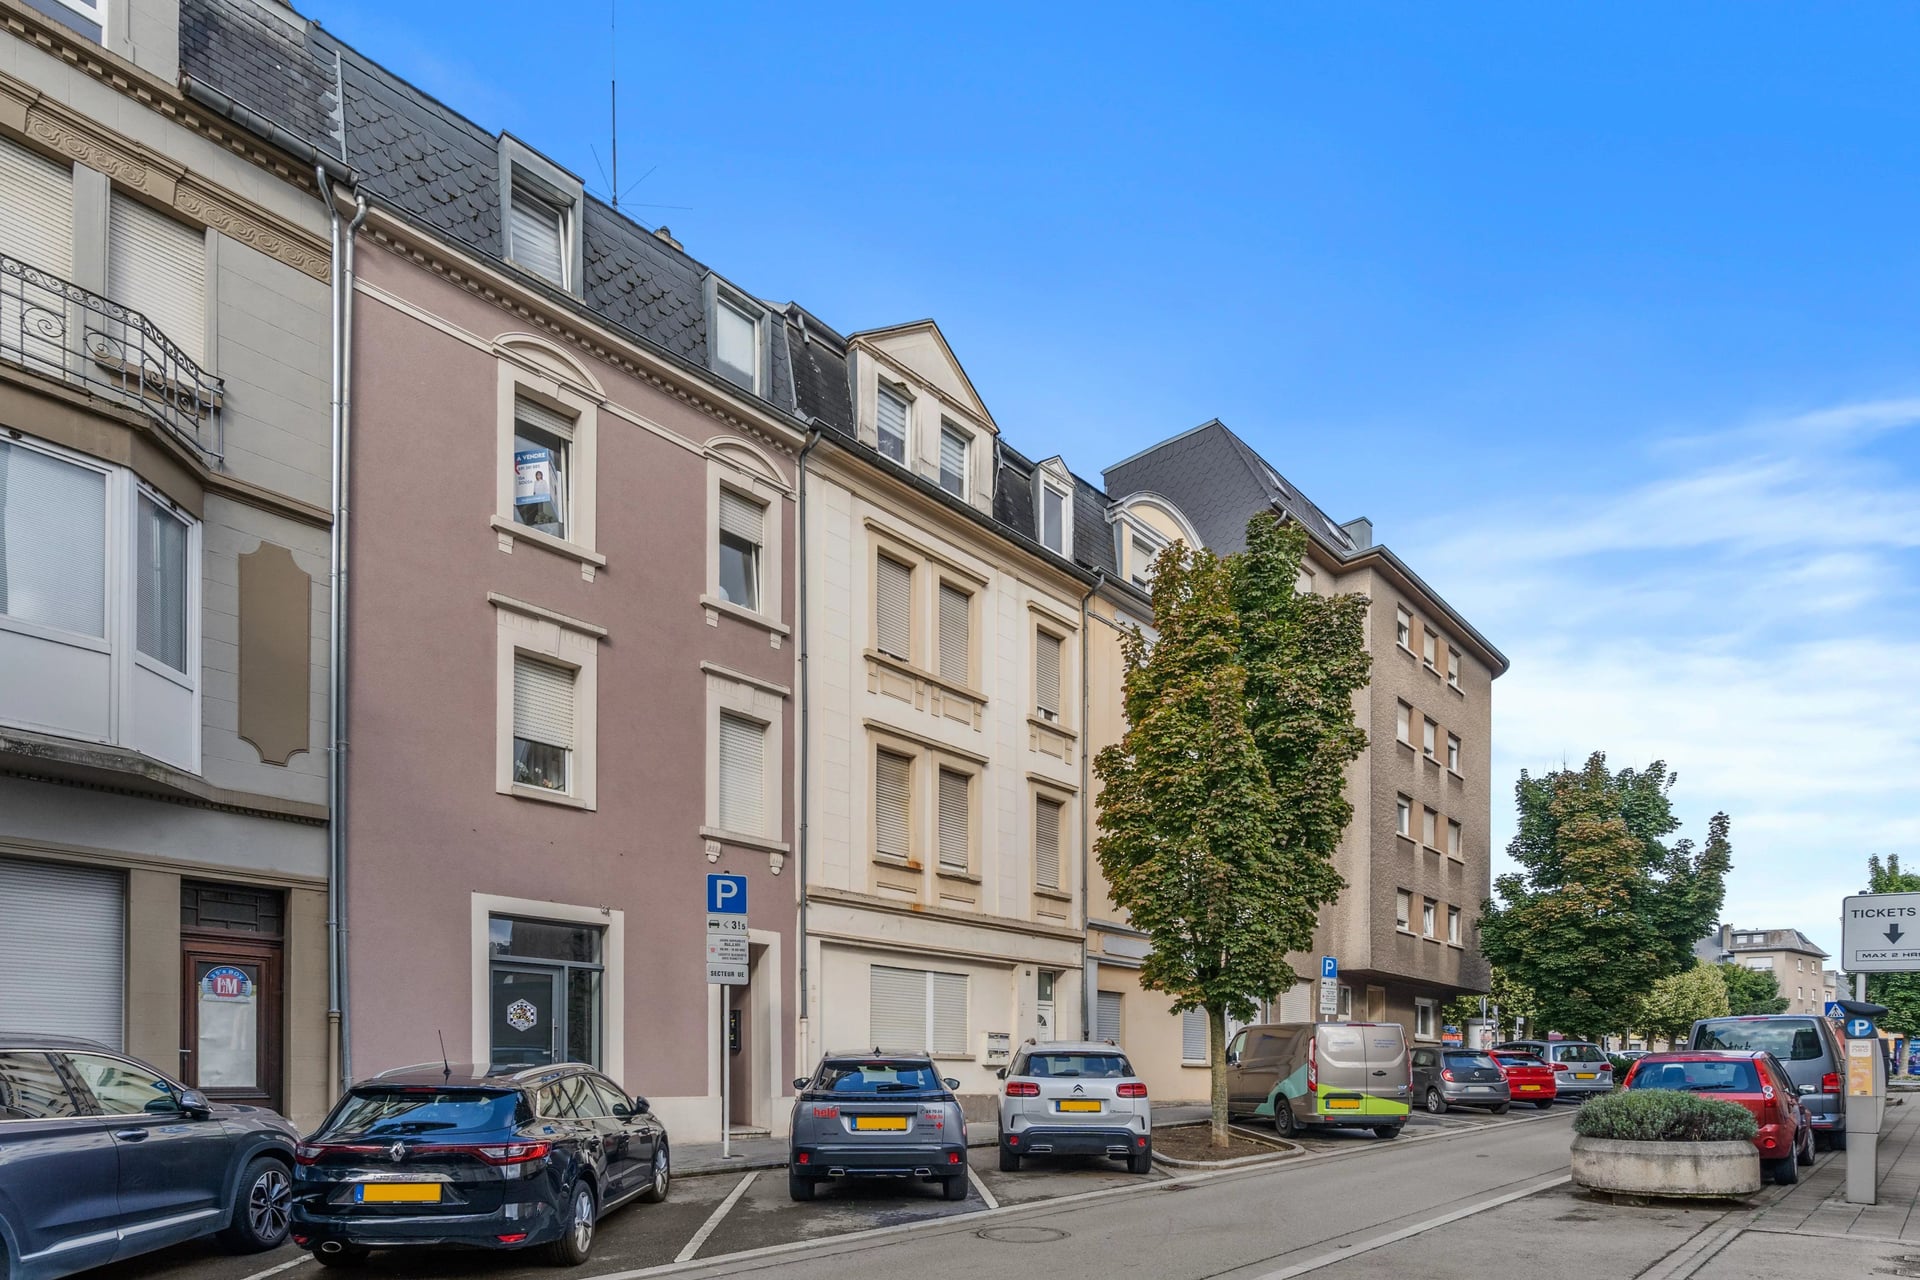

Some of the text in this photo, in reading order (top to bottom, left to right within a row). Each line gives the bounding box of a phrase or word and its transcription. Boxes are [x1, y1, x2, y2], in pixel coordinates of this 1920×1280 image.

[523, 452, 546, 460] VENDRE
[716, 879, 738, 909] P
[1851, 907, 1917, 919] TICKETS
[1325, 959, 1334, 976] P
[216, 977, 238, 994] L&M
[1854, 1019, 1869, 1036] P
[813, 1107, 838, 1119] help
